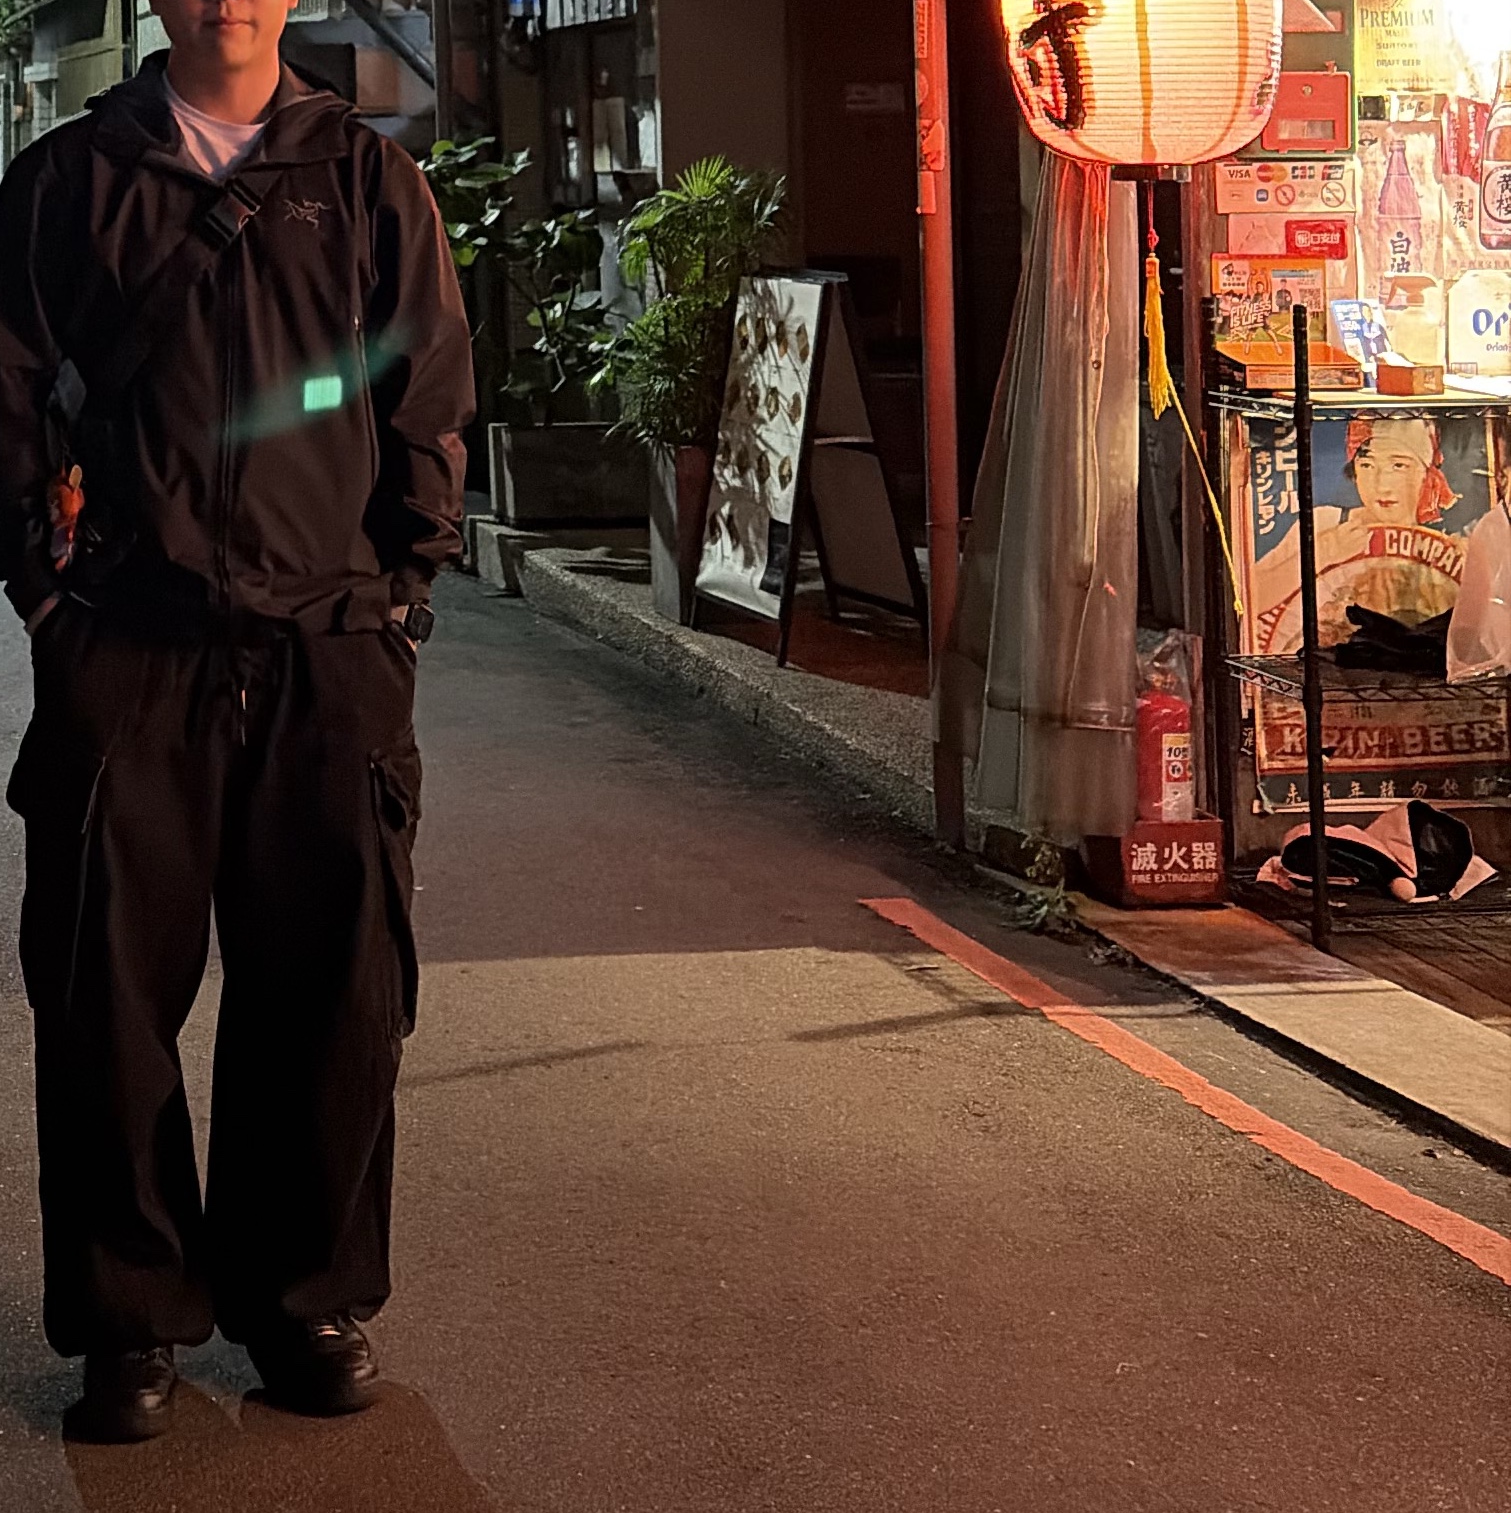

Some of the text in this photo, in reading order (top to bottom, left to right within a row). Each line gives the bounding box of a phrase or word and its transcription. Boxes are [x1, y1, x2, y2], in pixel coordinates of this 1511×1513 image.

[1360, 8, 1435, 28] PREMIUM
[1228, 169, 1251, 179] VISA
[1230, 300, 1272, 317] FITNESS
[1242, 313, 1265, 325] LIFE
[1130, 841, 1218, 872] 滅火器
[1131, 872, 1219, 884] FIRE EXTINGUISHER
